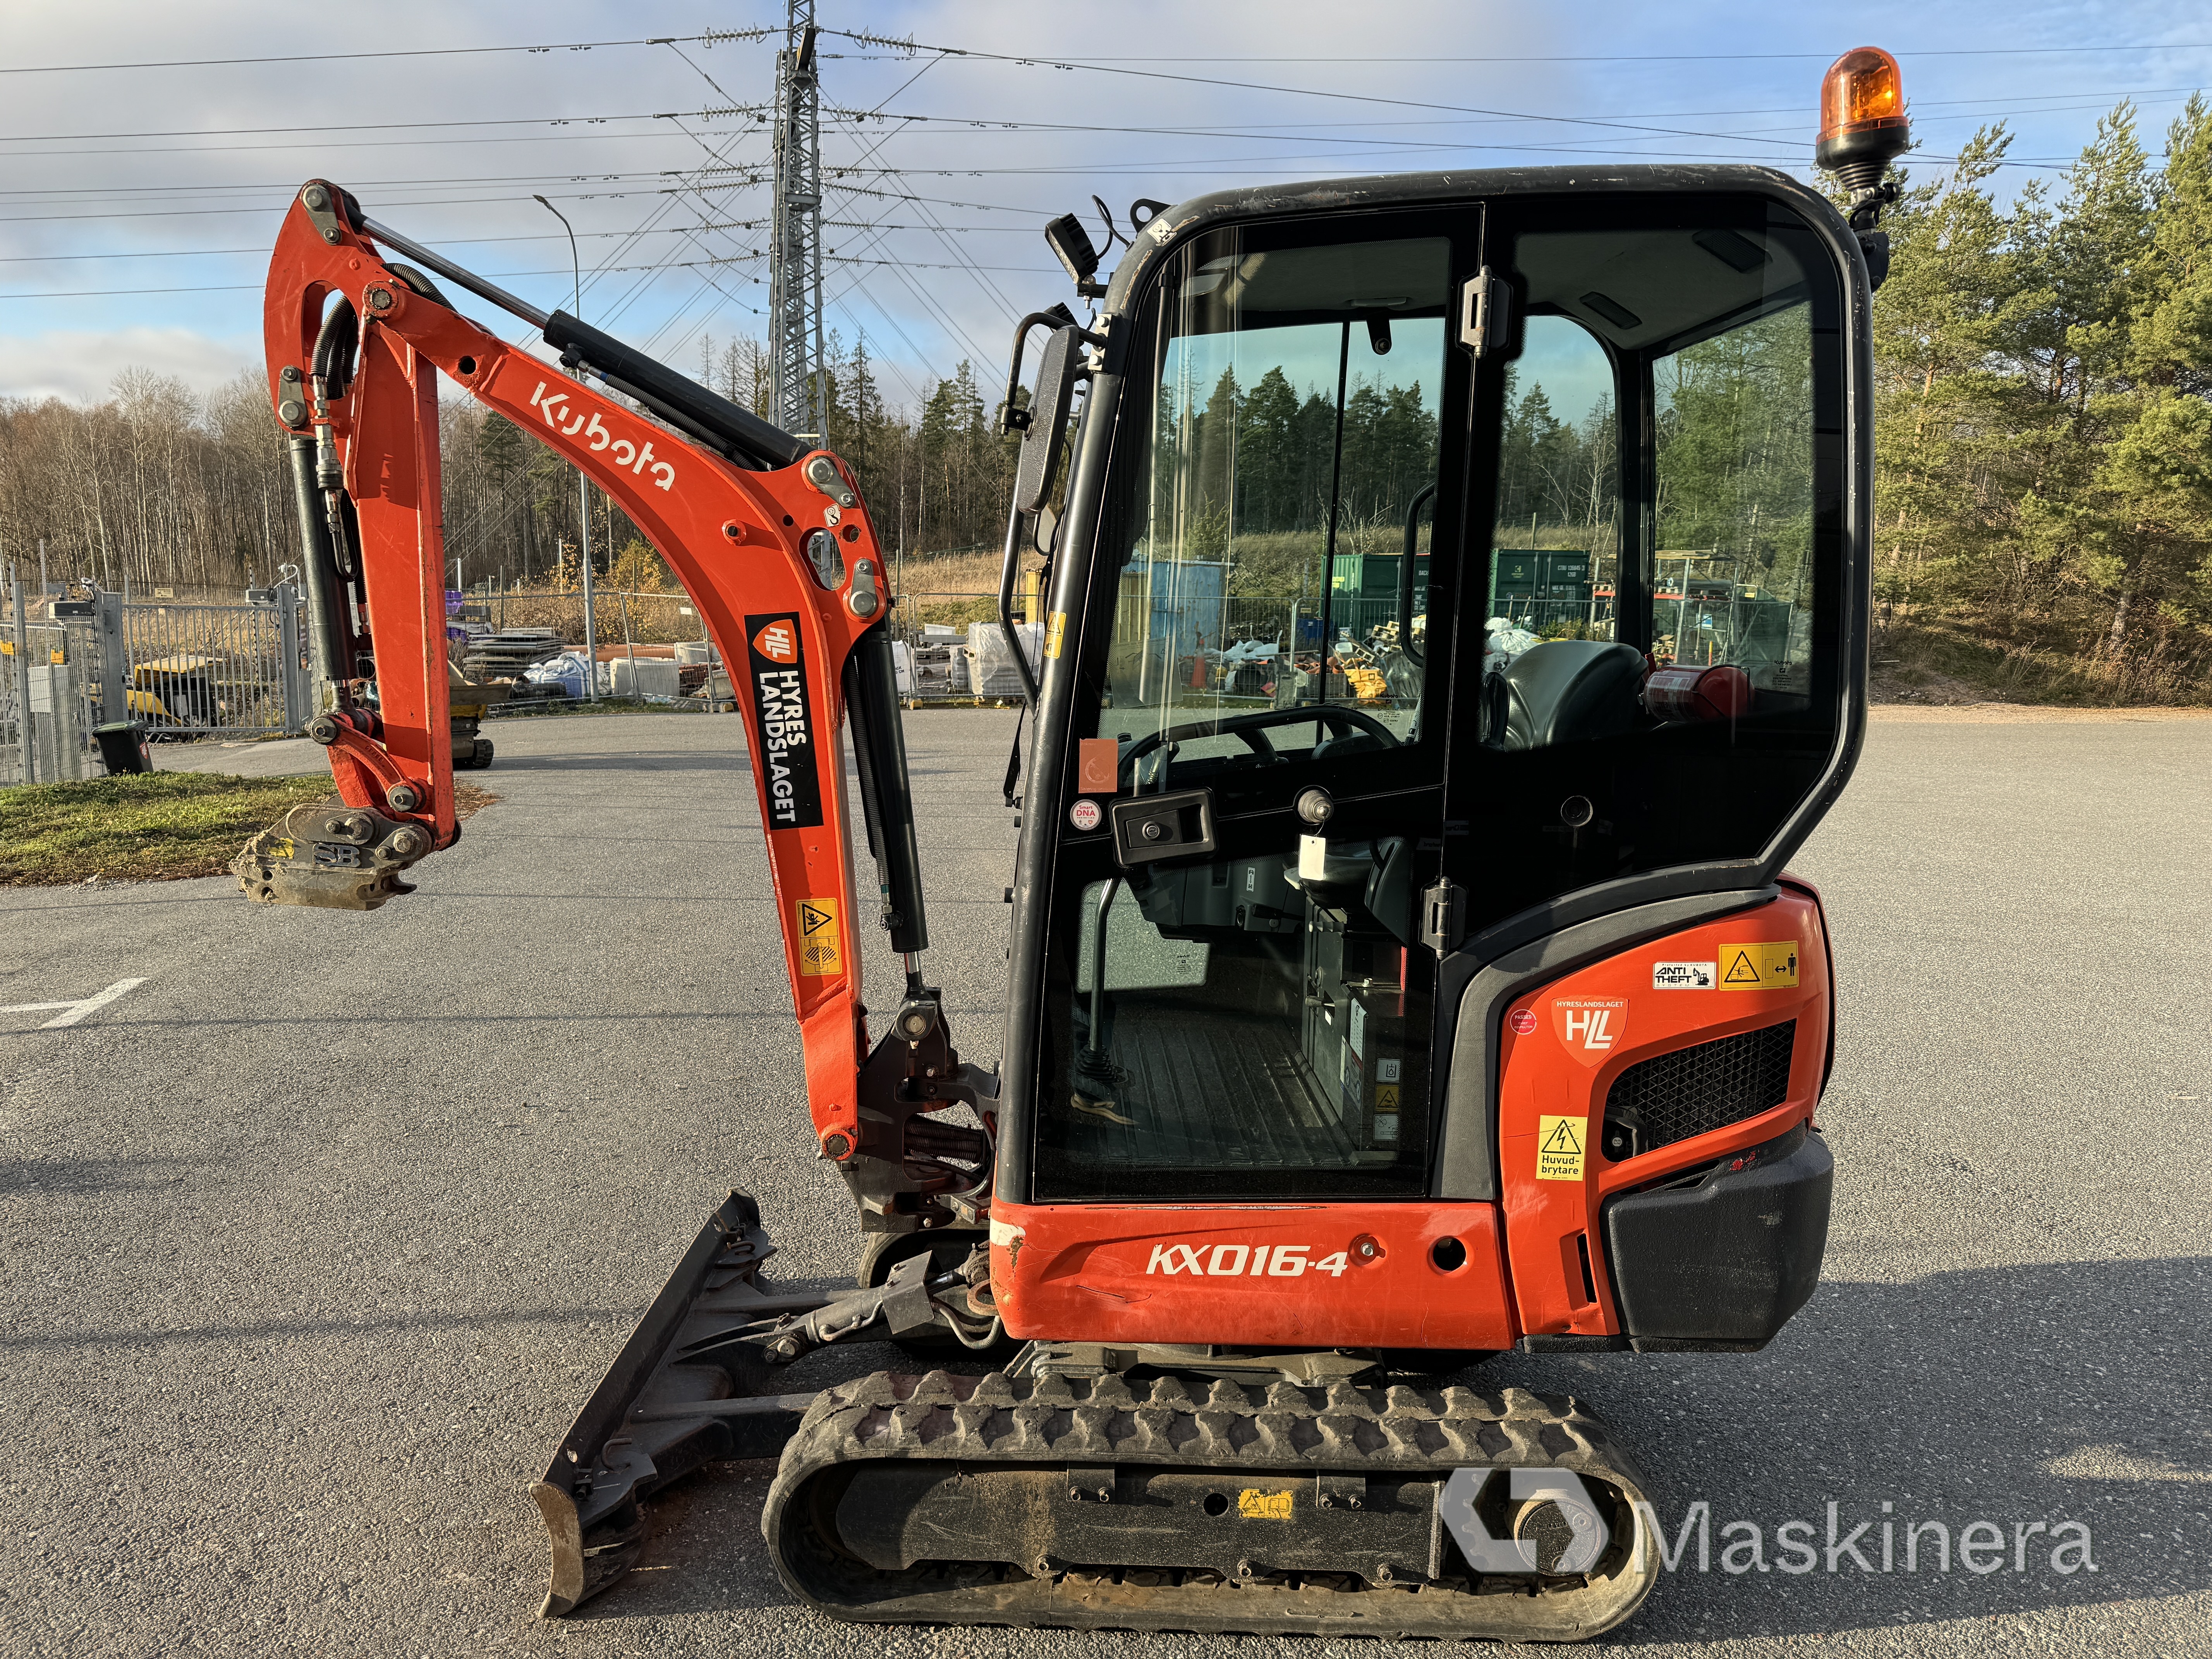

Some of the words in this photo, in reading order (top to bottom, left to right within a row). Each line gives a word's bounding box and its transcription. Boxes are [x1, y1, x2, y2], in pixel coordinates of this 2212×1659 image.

[530, 381, 676, 491] Kubota
[780, 670, 807, 746] HYRES
[759, 672, 796, 822] LANDSLAGET
[1541, 1164, 1578, 1175] brytare
[1542, 1155, 1580, 1164] Huvud-
[1146, 1244, 1348, 1277] KX016-4
